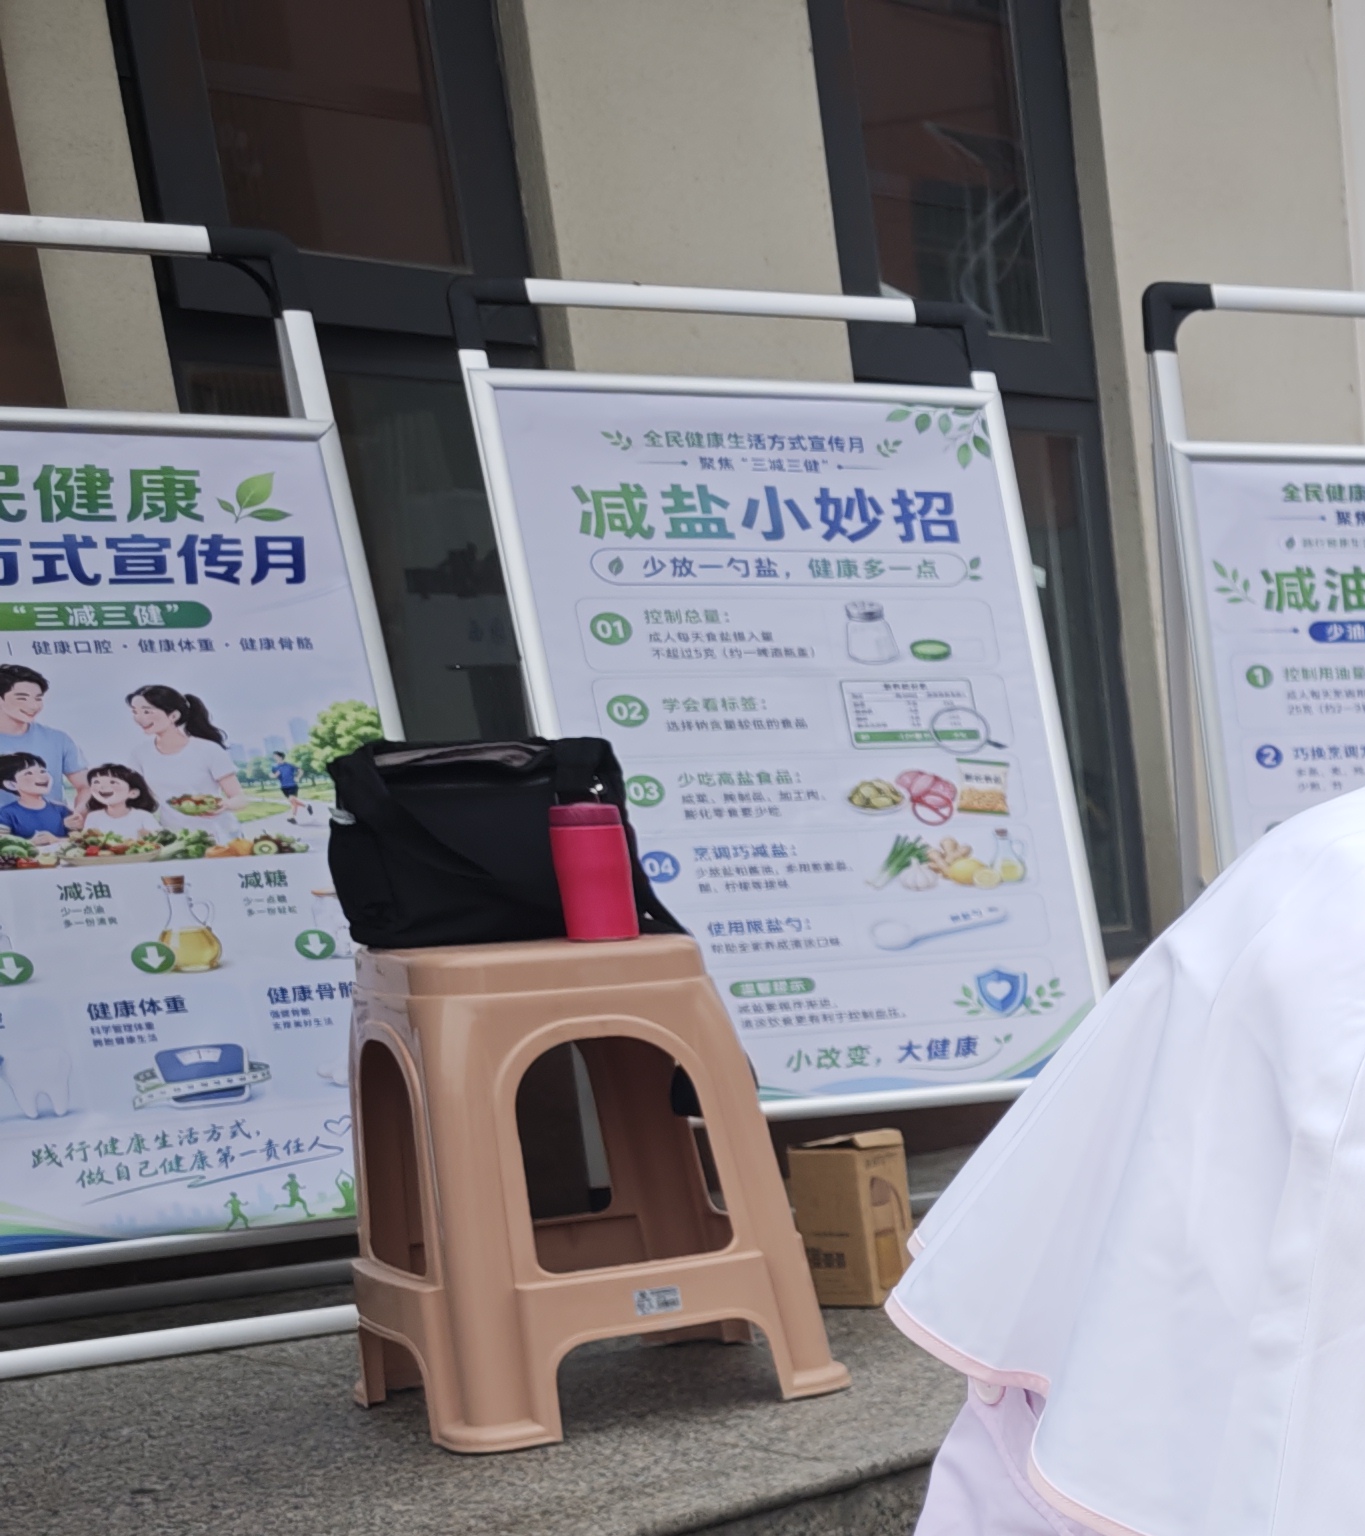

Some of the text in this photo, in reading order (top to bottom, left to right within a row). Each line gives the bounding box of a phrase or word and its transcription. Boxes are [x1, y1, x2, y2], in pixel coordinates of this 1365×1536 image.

[643, 429, 865, 454] 全民健康生活方式宣传月
[571, 483, 961, 544] 减盐小妙招
[642, 556, 940, 581] 少放一勺盐，健康多一点
[596, 619, 626, 640] 01
[1253, 667, 1265, 687] 1
[612, 702, 645, 721] 02
[1260, 745, 1278, 767] 2
[628, 782, 660, 800] 03
[643, 858, 676, 877] 04
[237, 870, 289, 889] 减糖
[57, 881, 112, 902] 减油
[87, 995, 189, 1021] 健康体重
[75, 1136, 344, 1189] 做自己健康第一责任人
